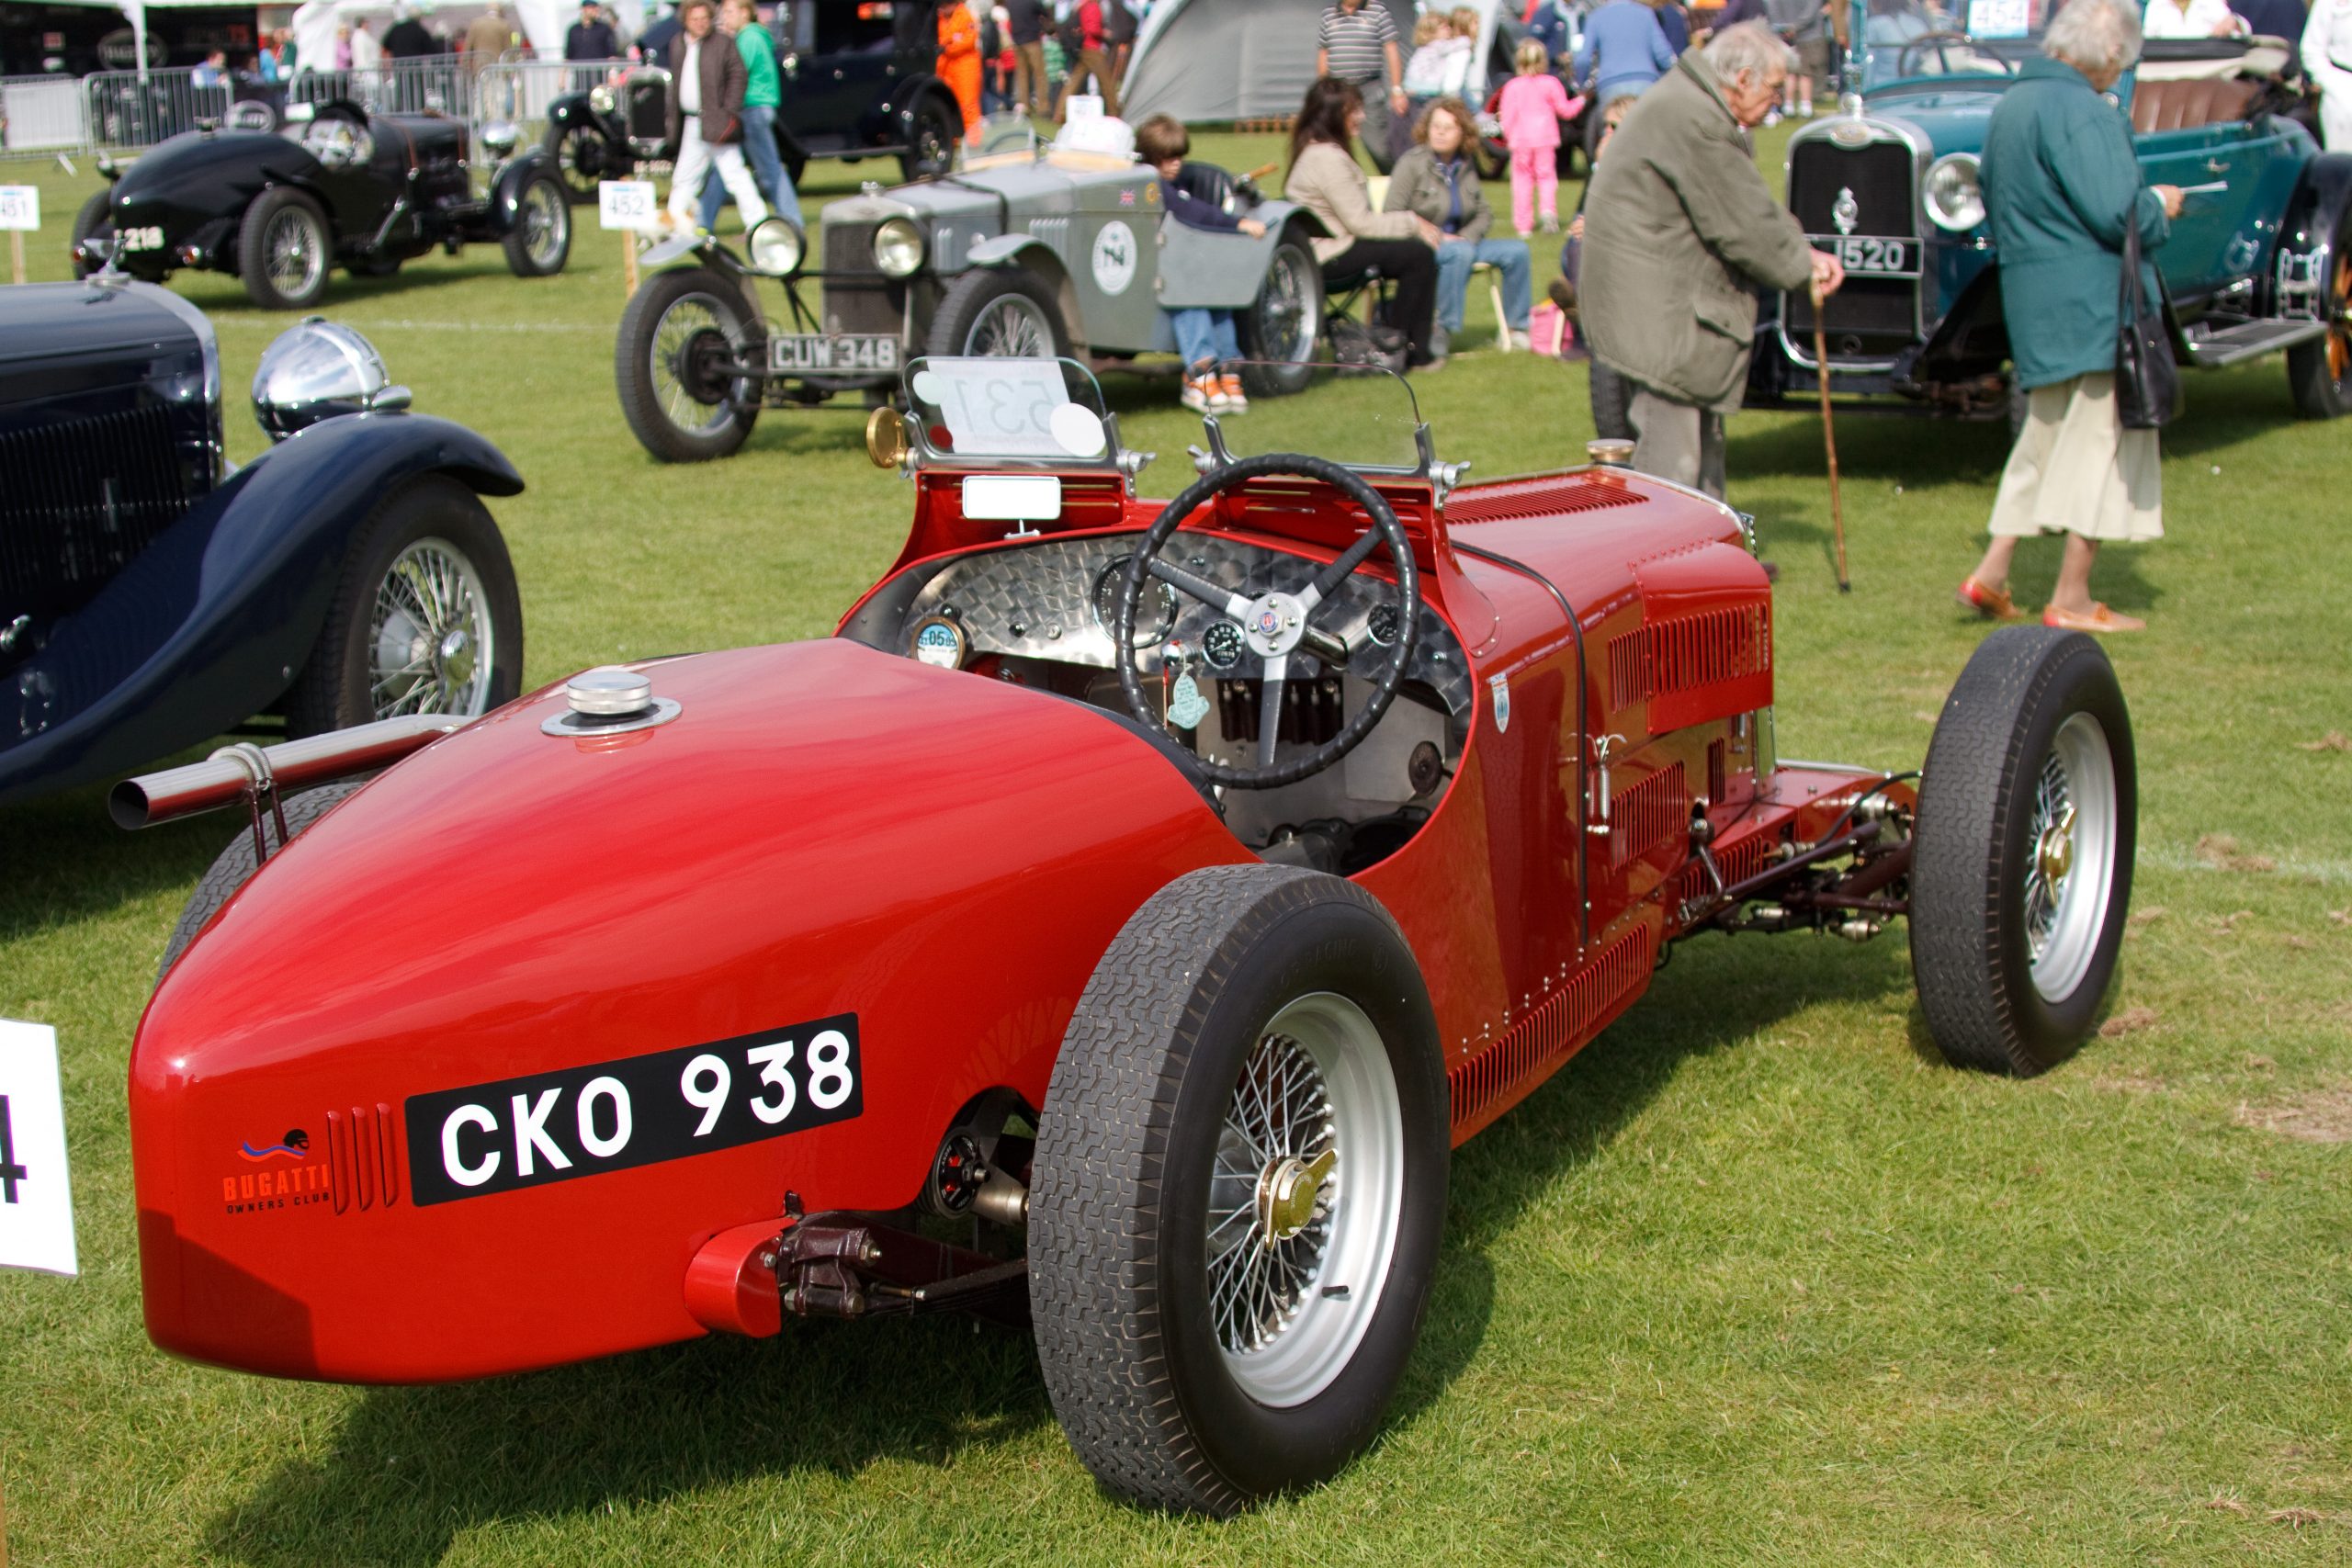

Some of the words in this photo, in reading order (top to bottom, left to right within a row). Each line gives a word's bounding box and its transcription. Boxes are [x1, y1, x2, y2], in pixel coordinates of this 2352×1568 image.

[608, 195, 644, 216] 452
[775, 339, 831, 367] CUW
[837, 338, 896, 367] 348
[929, 630, 944, 646] 05
[441, 1077, 632, 1187] CKO
[681, 1030, 854, 1137] 938
[223, 1164, 329, 1201] BUGATTI
[228, 1199, 285, 1213] OWNERS
[294, 1192, 330, 1206] CLUB
